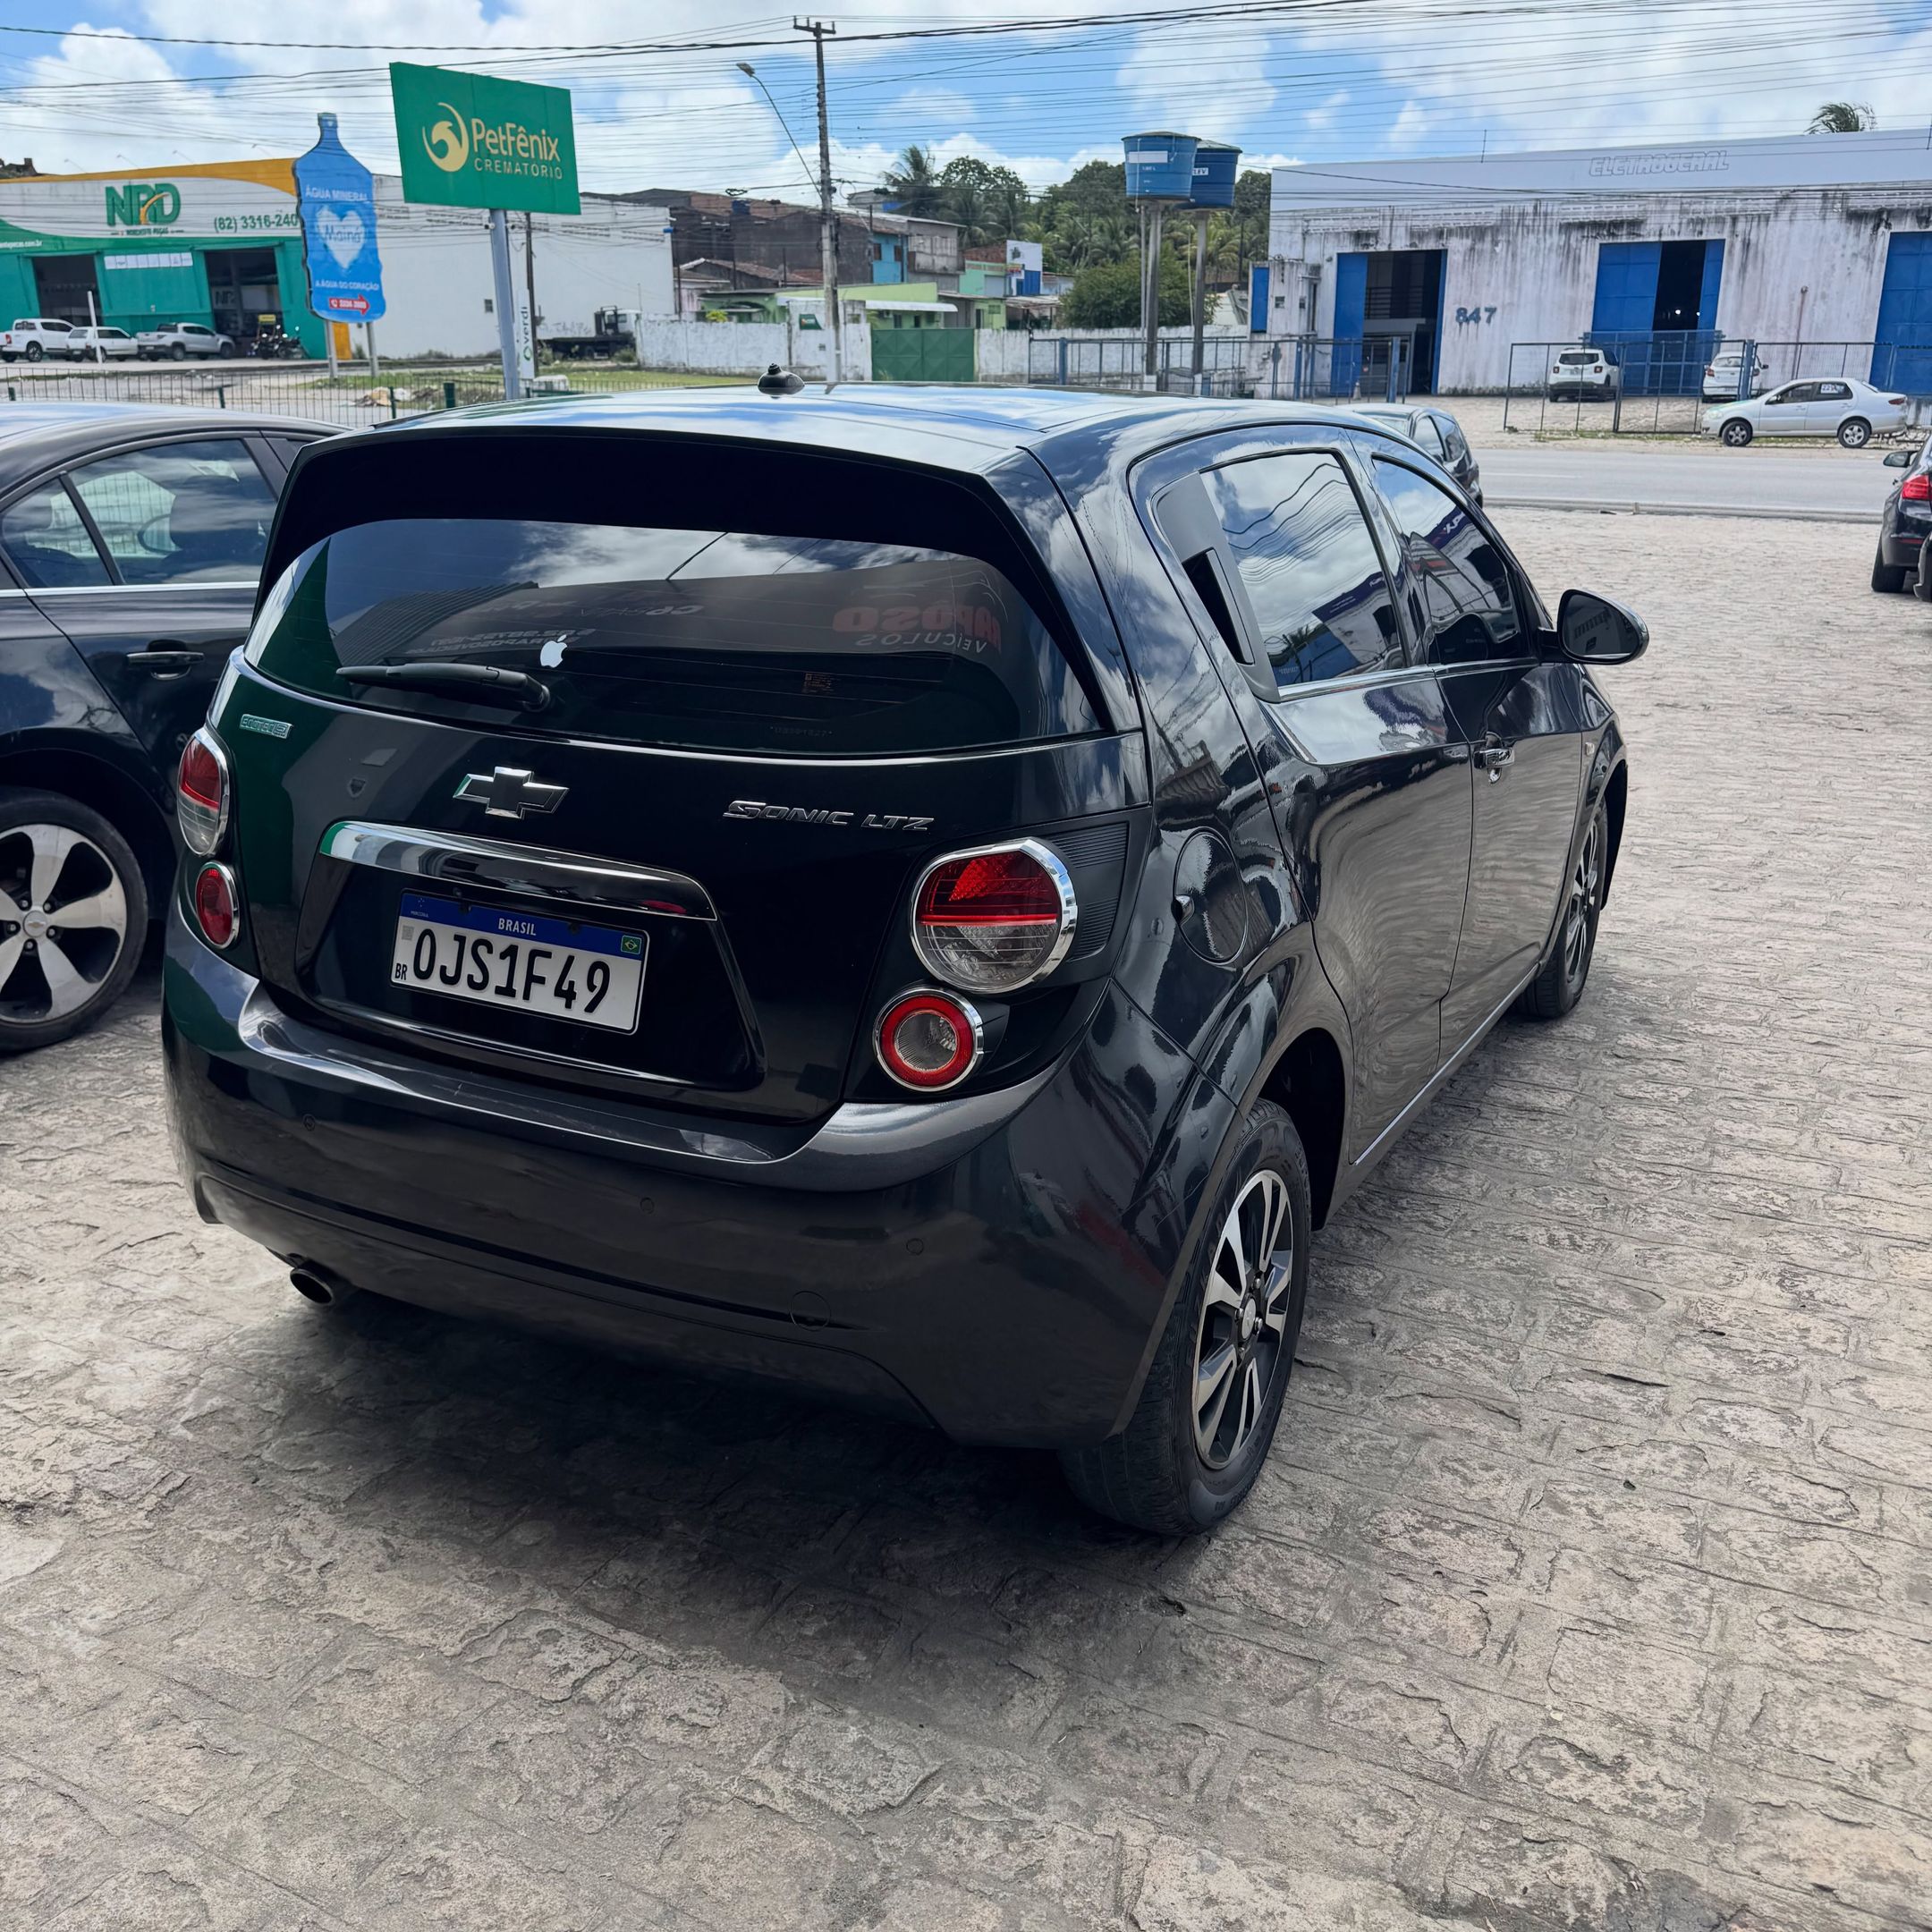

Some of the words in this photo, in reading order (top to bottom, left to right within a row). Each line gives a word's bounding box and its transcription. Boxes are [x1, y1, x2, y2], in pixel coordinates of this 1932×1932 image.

[471, 117, 561, 162] PetFênix
[1589, 150, 1729, 177] ELETROGERAL
[305, 184, 331, 199] ÁGUA
[332, 189, 368, 202] MINERAL
[214, 216, 237, 233] (82)
[1455, 307, 1497, 323] 847
[723, 800, 854, 826] SONIC
[861, 814, 935, 831] LTZ
[497, 917, 537, 936] BRASIL
[394, 962, 408, 981] BR
[413, 928, 611, 1013] OJS1F49
